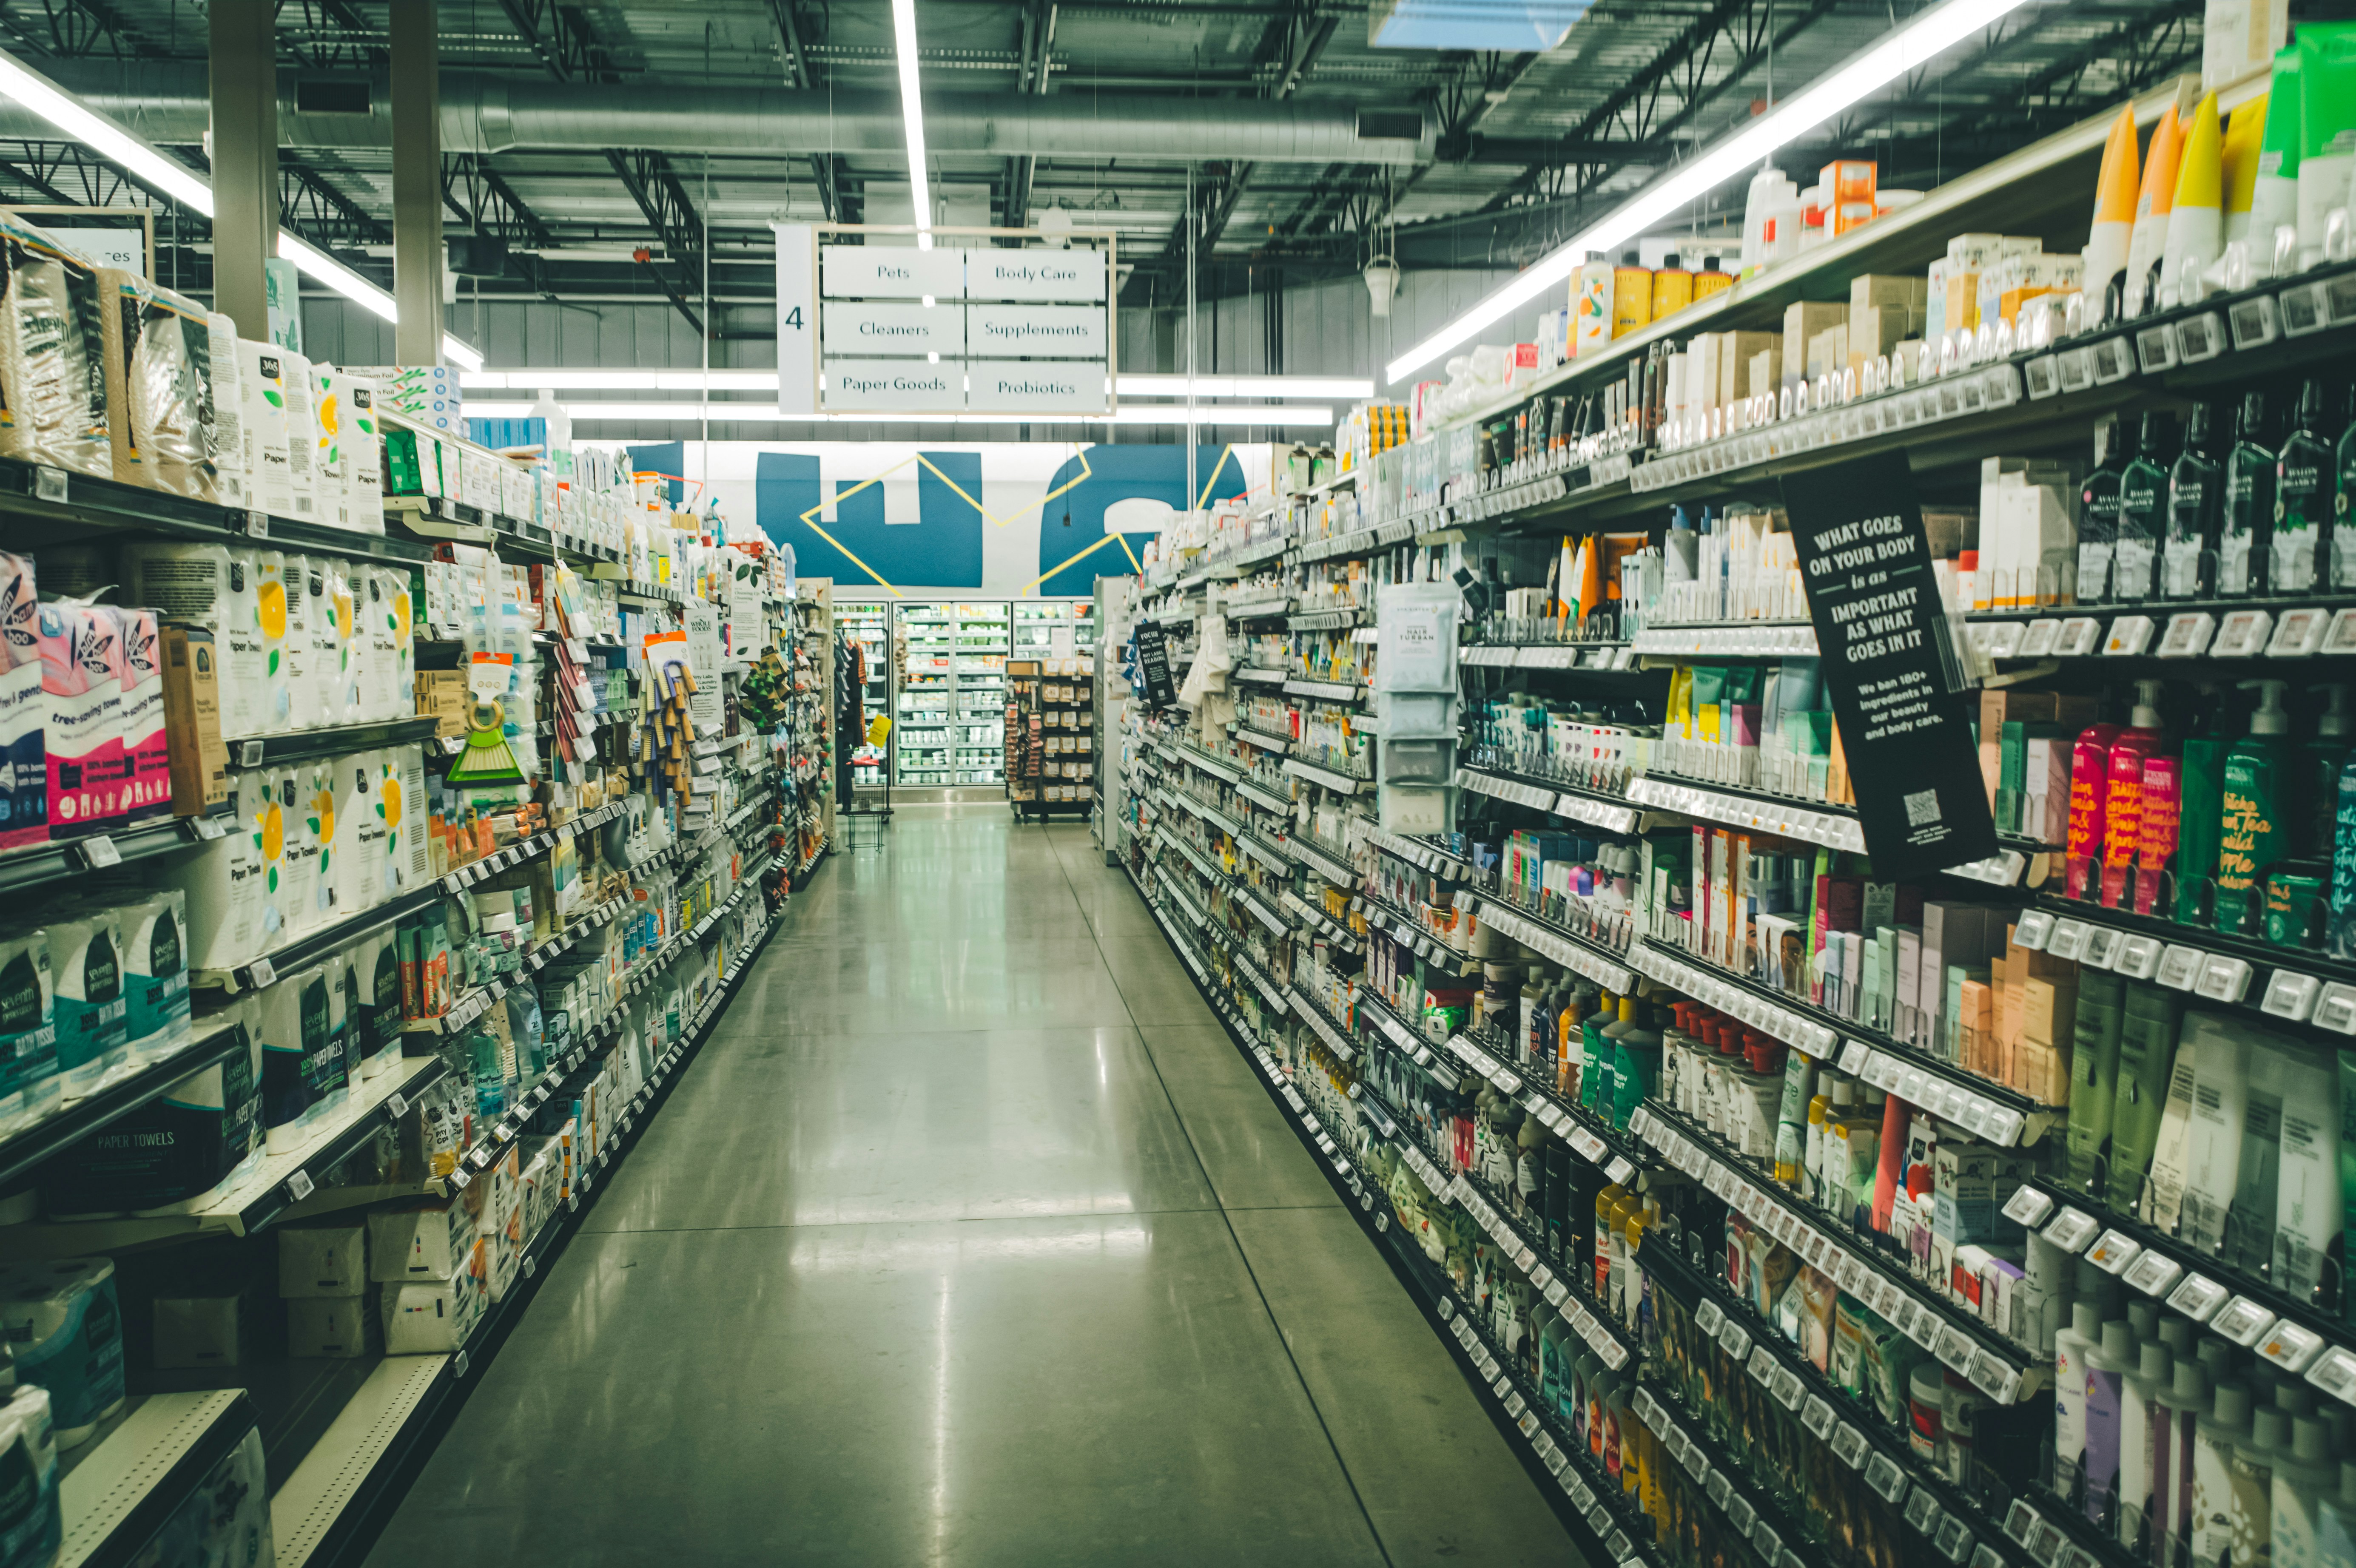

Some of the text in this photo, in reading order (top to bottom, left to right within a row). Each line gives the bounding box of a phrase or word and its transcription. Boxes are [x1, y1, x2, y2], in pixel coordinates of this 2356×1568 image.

[877, 266, 910, 279] Pets
[996, 267, 1076, 283] Body Care
[785, 307, 804, 330] 4
[860, 322, 929, 335] Cleaners
[985, 322, 1088, 338] Supplements
[262, 360, 278, 372] 365
[843, 377, 946, 393] Paper Goods
[998, 381, 1075, 394] Probiotics
[356, 391, 370, 401] 365
[264, 453, 286, 464] Paper
[358, 475, 377, 484] Paper
[1813, 515, 1903, 552] WHAT GOES
[1809, 534, 1915, 577] ON YOUR BODY
[1851, 574, 1866, 590] is
[1830, 586, 1918, 624] IMPORTANT
[1847, 609, 1913, 641] AS WHAT
[1140, 631, 1158, 641] FOCUS
[1846, 629, 1922, 663] GOES IN IT
[1144, 655, 1165, 665] READING
[1858, 683, 1876, 696] We
[1876, 679, 1898, 691] ban
[1859, 685, 1933, 711] ingredients in
[52, 703, 102, 724] tree-saving
[1870, 701, 1929, 723] our beauty
[1864, 714, 1943, 741] and body care.
[154, 939, 176, 957] seventh
[88, 962, 114, 981] seventh
[1, 986, 34, 1009] seventh
[16, 1034, 34, 1057] BATH
[313, 1047, 327, 1069] PAPER
[98, 1131, 174, 1149] PAPER TOWELS
